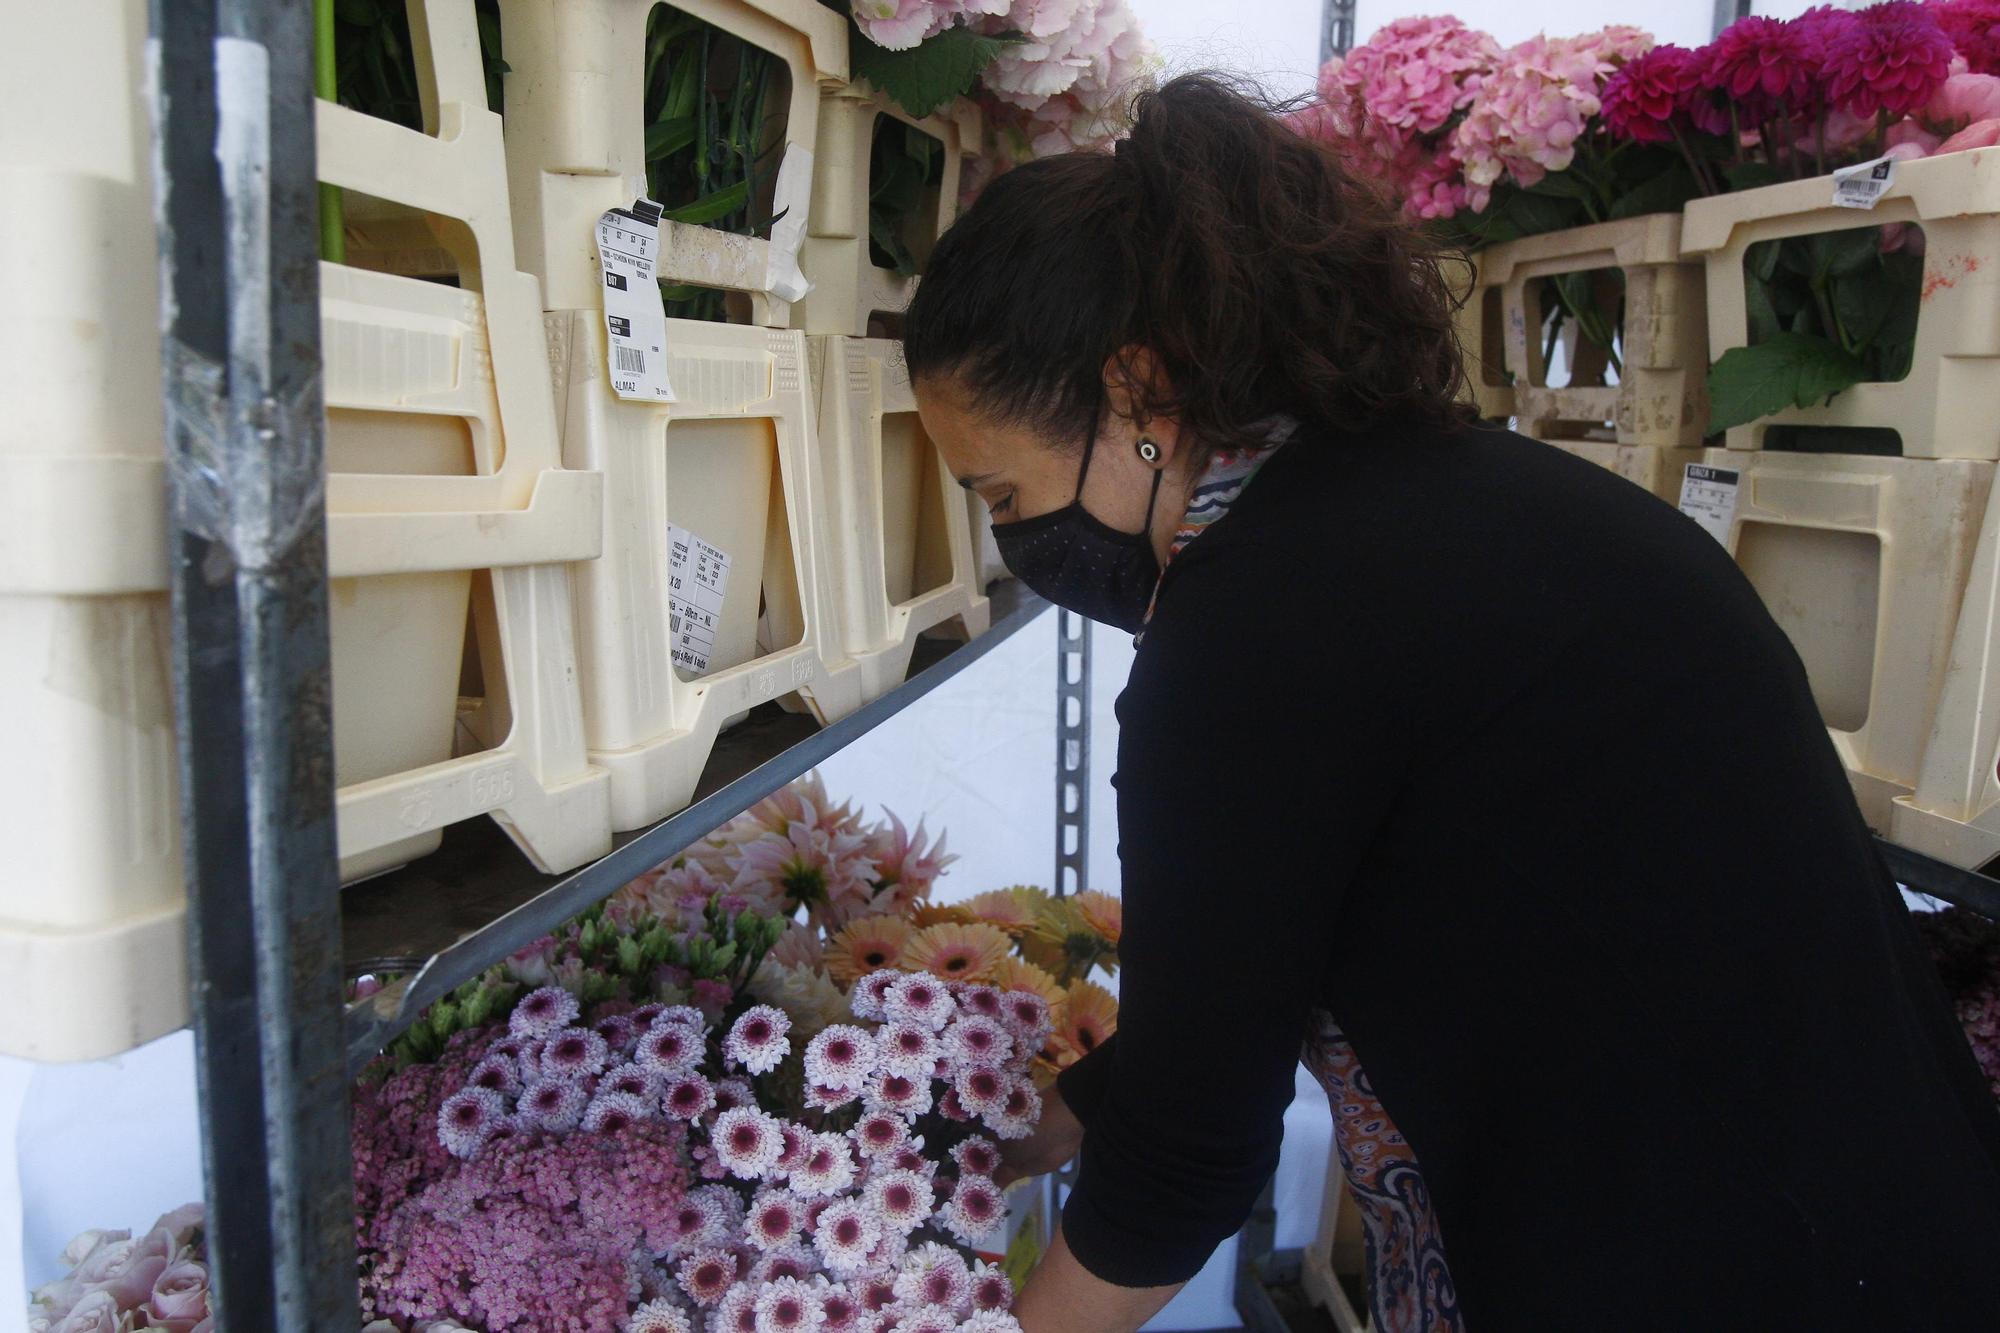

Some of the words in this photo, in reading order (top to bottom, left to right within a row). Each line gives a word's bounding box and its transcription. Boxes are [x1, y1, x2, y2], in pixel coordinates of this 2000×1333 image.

[641, 238, 647, 247] S4
[615, 380, 636, 392] ALMAZ
[673, 577, 682, 590] 20
